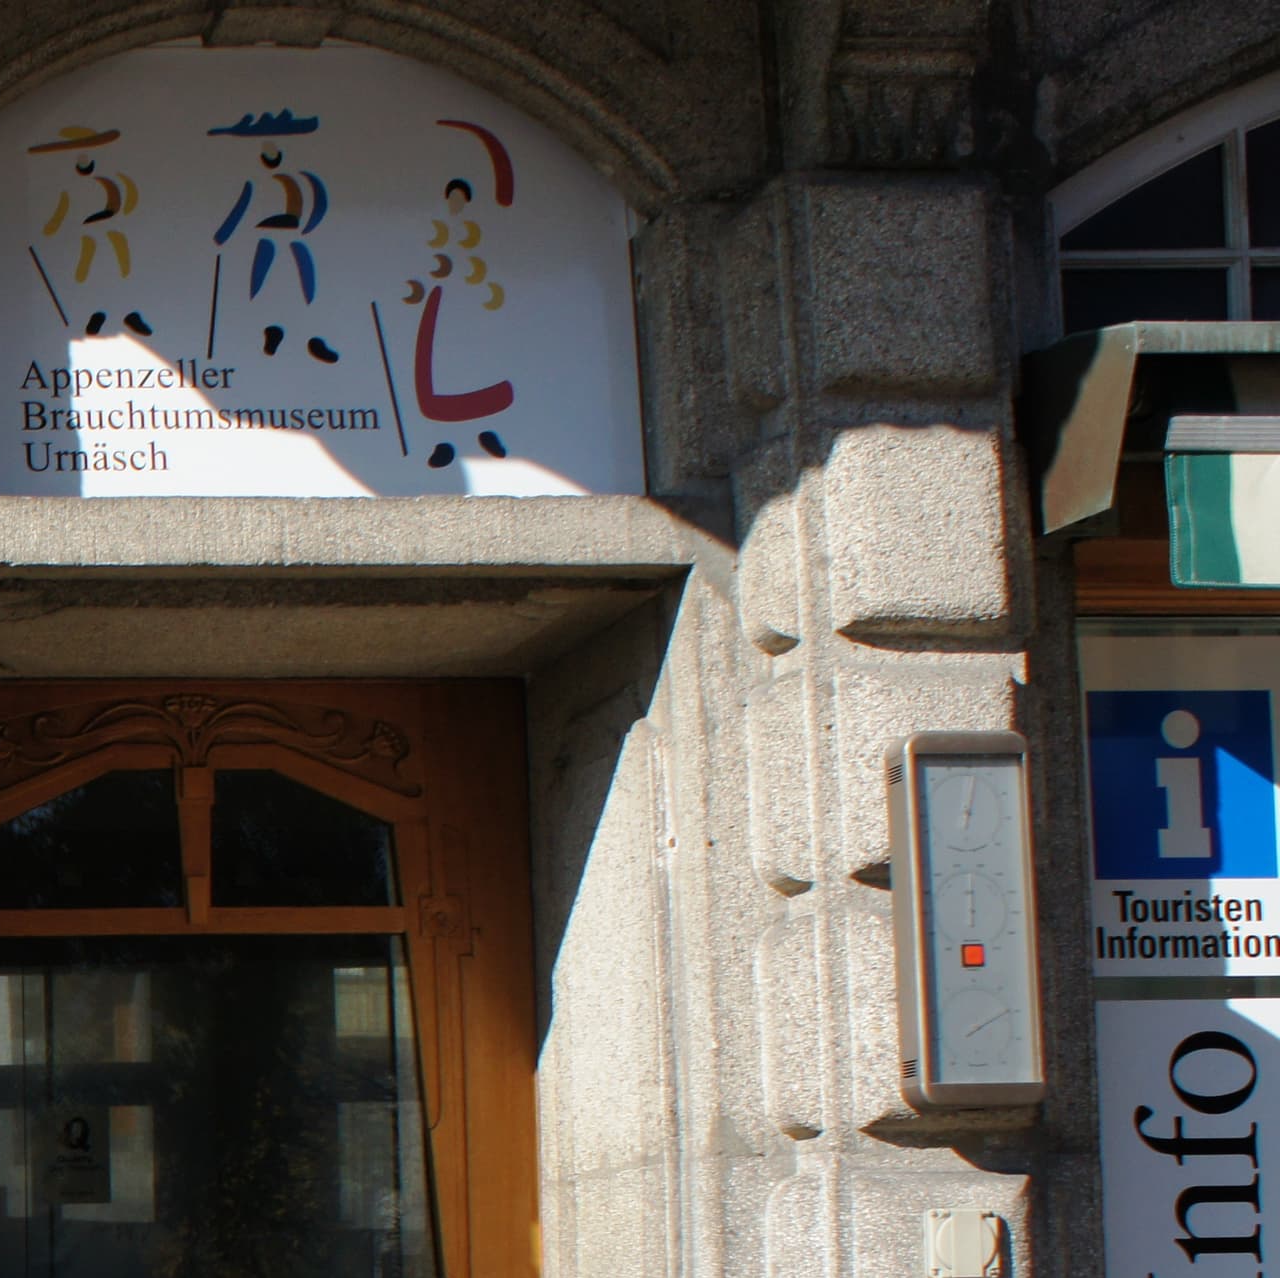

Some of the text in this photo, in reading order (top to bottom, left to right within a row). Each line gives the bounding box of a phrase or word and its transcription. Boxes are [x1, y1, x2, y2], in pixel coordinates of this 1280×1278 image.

[20, 359, 235, 398] Appenzeller
[21, 401, 381, 431] Brauchtumsmuseum
[23, 441, 170, 472] Urnäsch
[1112, 889, 1263, 923] Touristen
[1095, 926, 1280, 959] Information
